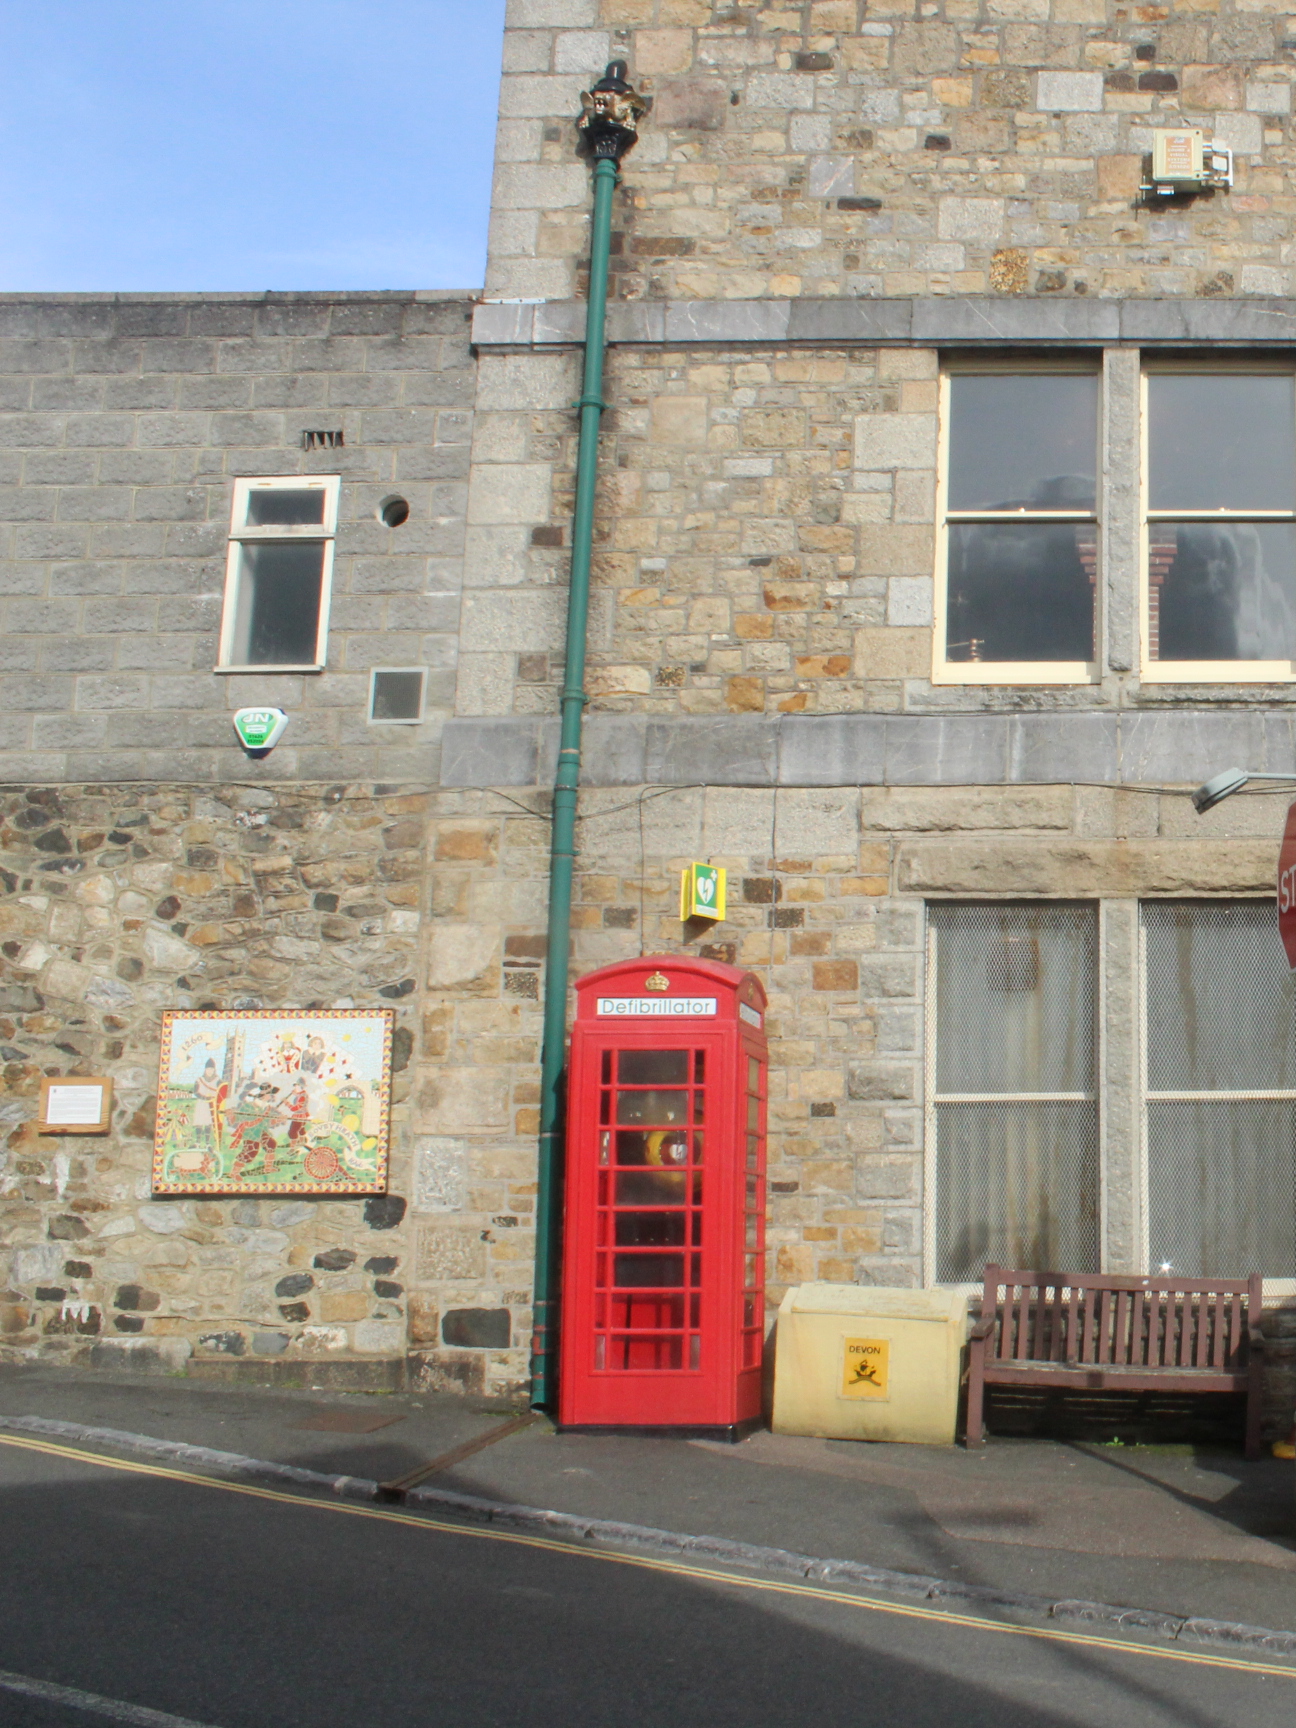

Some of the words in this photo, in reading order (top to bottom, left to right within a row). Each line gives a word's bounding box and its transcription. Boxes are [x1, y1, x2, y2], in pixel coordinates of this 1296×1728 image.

[242, 713, 269, 723] JN
[602, 999, 711, 1014] Defibrillator
[181, 1035, 203, 1051] 1260
[309, 1123, 333, 1138] BOVEY
[335, 1124, 359, 1148] HEATH
[848, 1345, 881, 1355] DEVON
